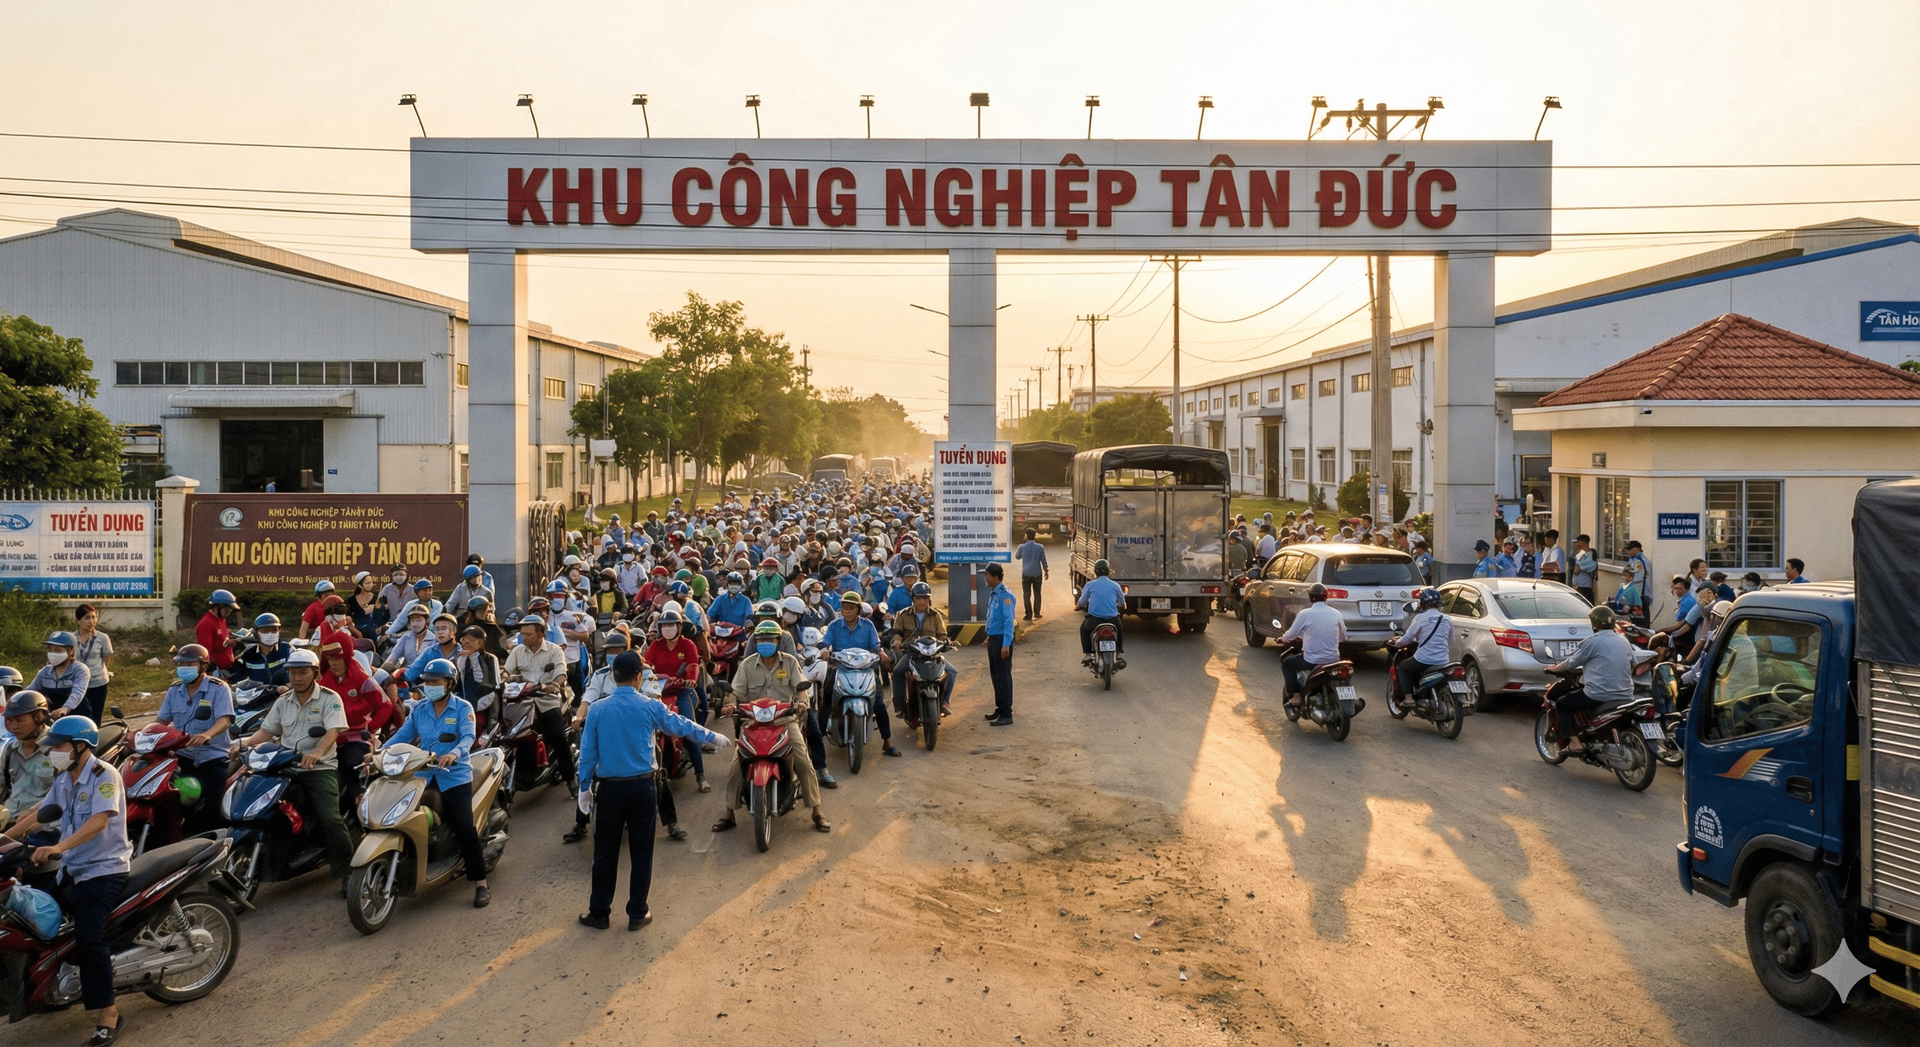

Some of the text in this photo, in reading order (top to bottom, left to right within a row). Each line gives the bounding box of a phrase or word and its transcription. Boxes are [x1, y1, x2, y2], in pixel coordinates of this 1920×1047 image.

[507, 152, 1457, 241] KHU CÔNG NGHIỆP TÂN ĐỨC
[1878, 312, 1900, 326] TÂN
[50, 506, 145, 536] TUYỂN DỤNG
[257, 520, 275, 530] KHU
[211, 537, 441, 571] KHU CÔNG NGHIỆP TÂN ĐỨC
